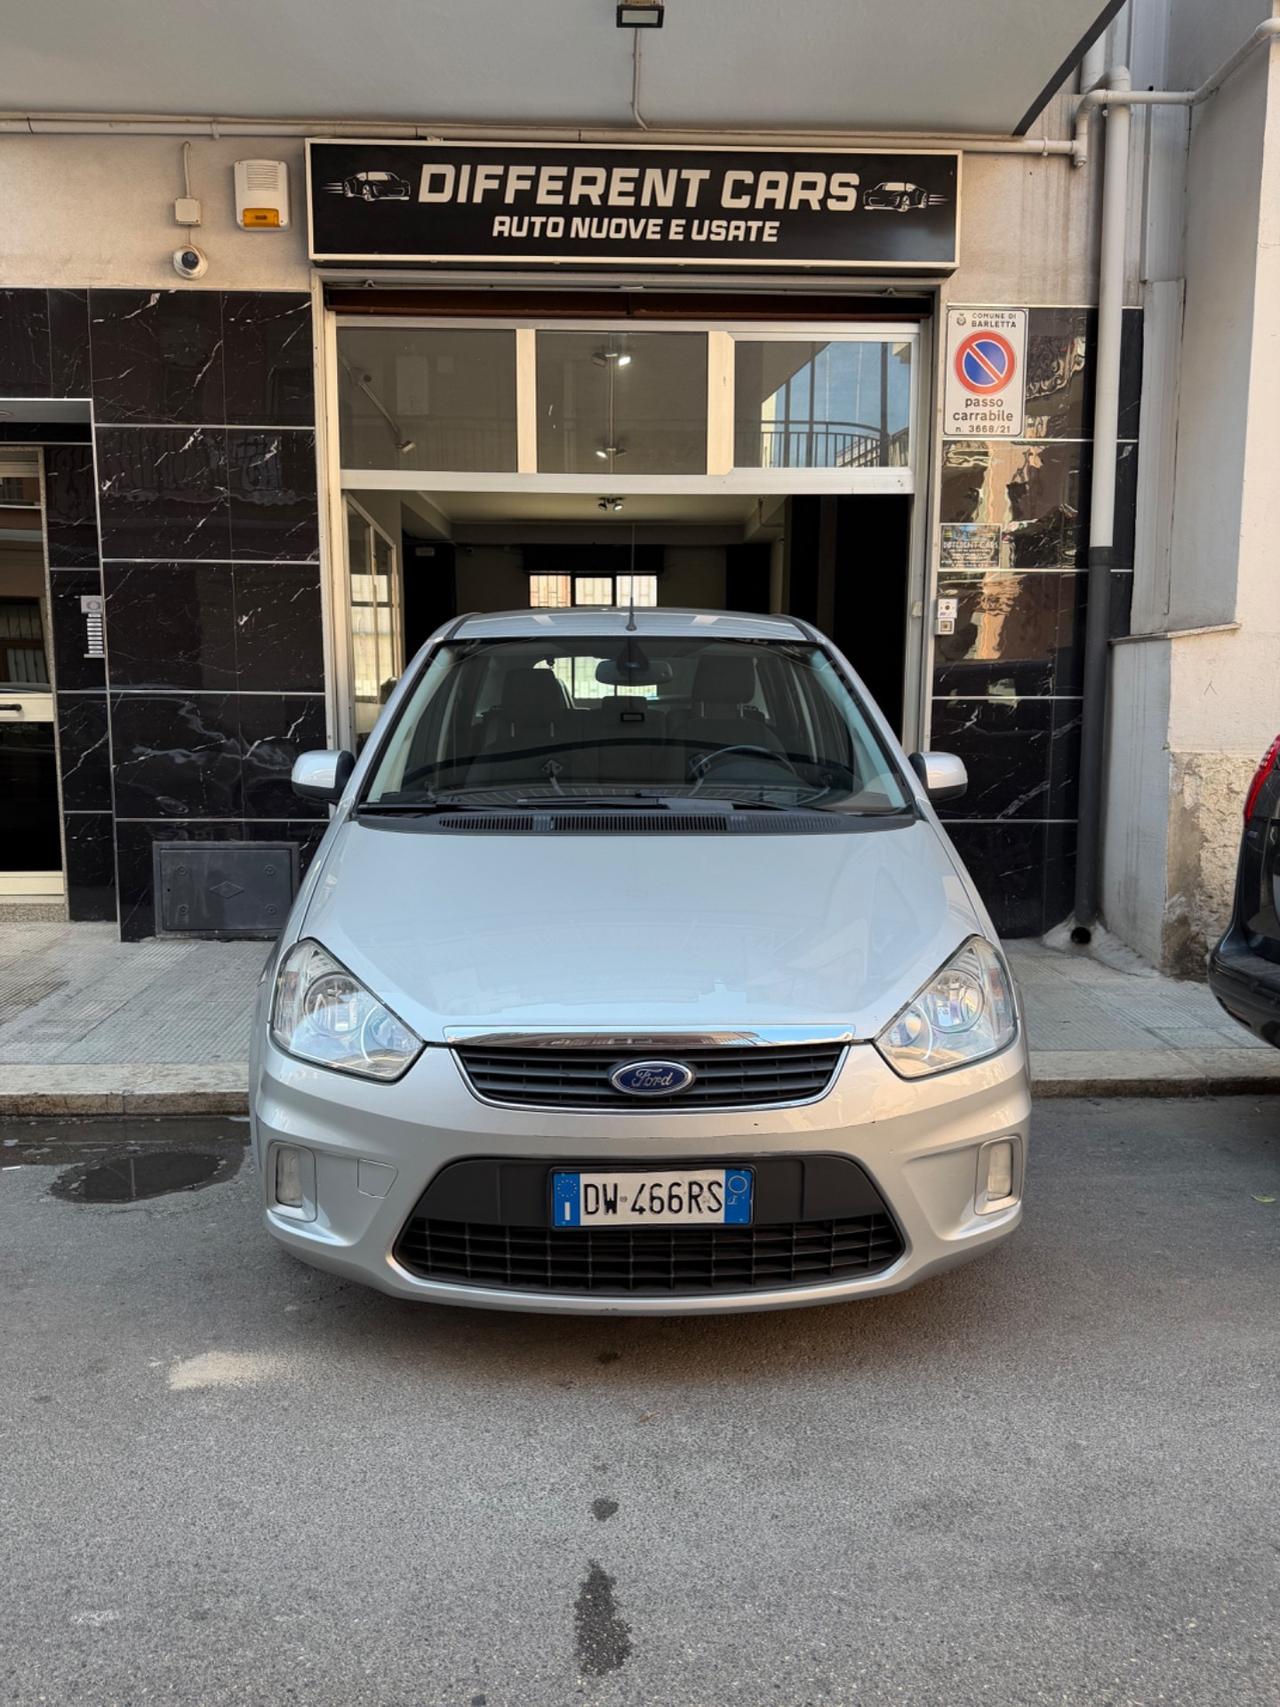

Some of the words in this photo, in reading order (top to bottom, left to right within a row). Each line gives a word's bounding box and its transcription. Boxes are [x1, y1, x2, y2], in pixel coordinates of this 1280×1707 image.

[418, 163, 711, 208] DIFFERENT
[721, 169, 860, 212] CARS
[492, 215, 565, 238] AUTO
[570, 217, 664, 240] NUOVE
[668, 218, 686, 240] E
[691, 219, 780, 242] USATE
[971, 320, 1017, 328] BARLETTA
[965, 397, 1004, 408] passo
[952, 409, 1014, 422] carrabile
[631, 1068, 673, 1088] Ford
[583, 1183, 618, 1215] DW
[630, 1180, 723, 1215] 466RS
